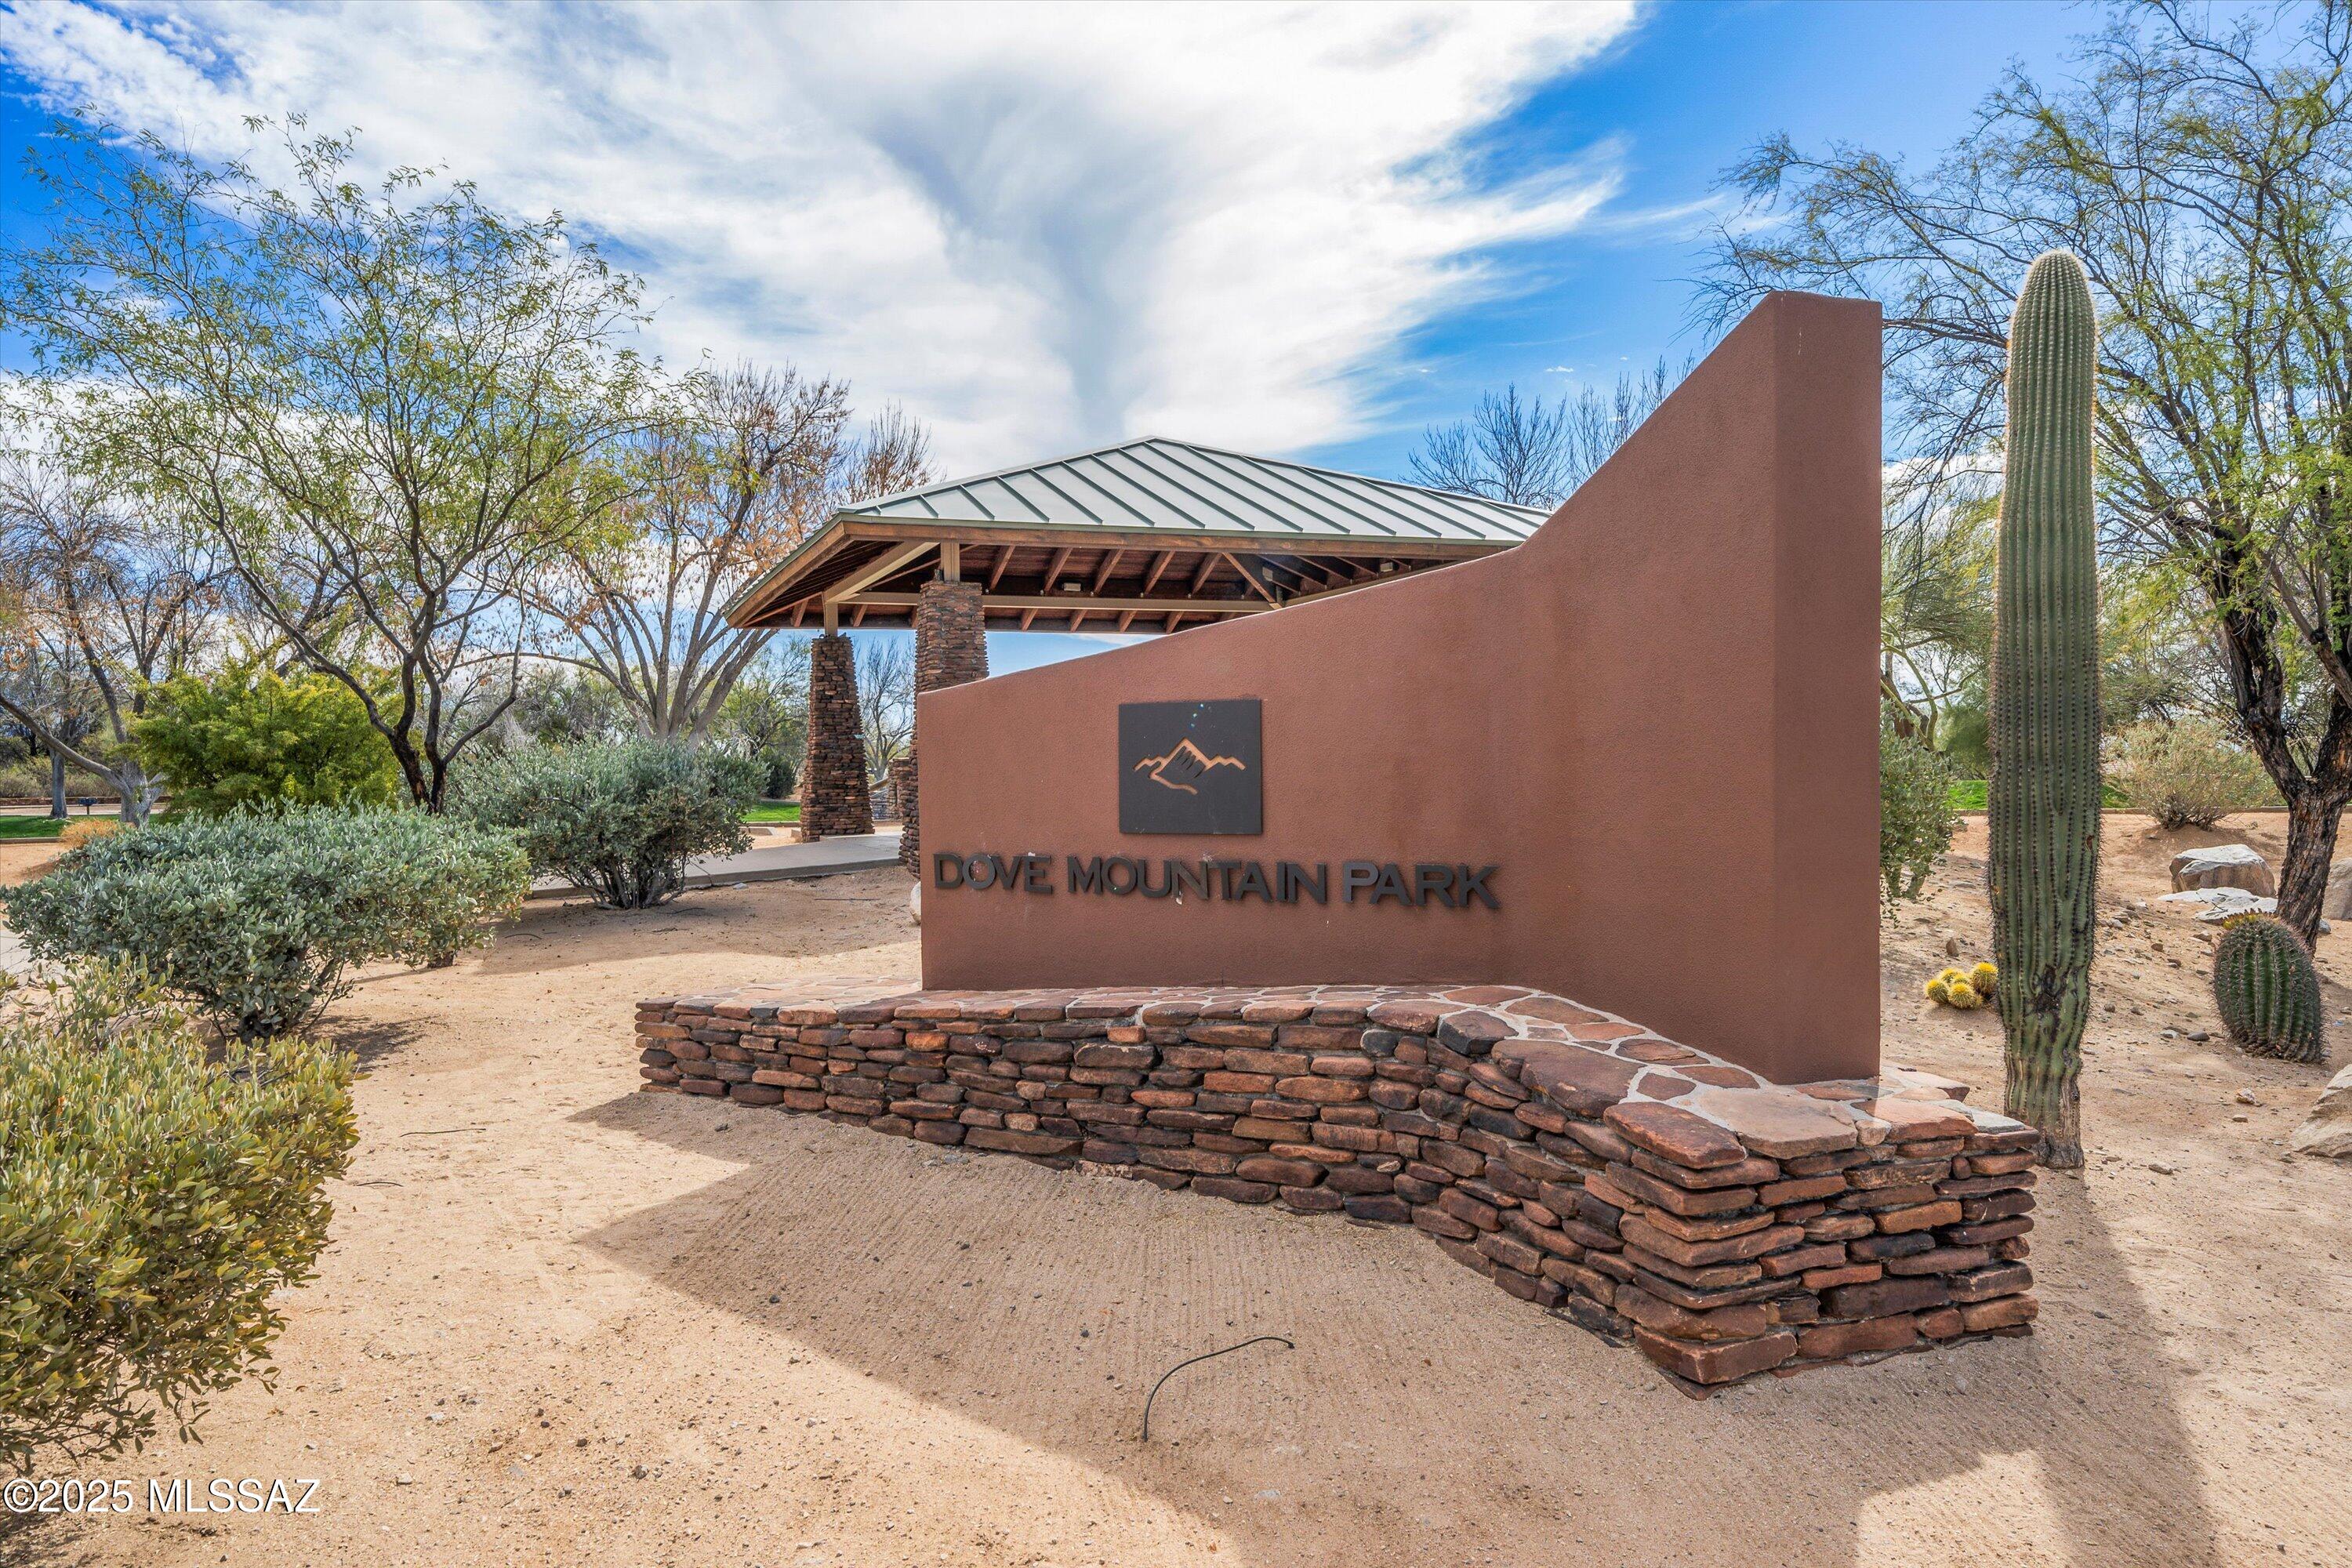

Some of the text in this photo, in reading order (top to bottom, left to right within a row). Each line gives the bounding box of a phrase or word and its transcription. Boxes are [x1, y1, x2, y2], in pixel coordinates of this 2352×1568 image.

[933, 853, 1501, 909] DOVE MOUNTAIN PARK
